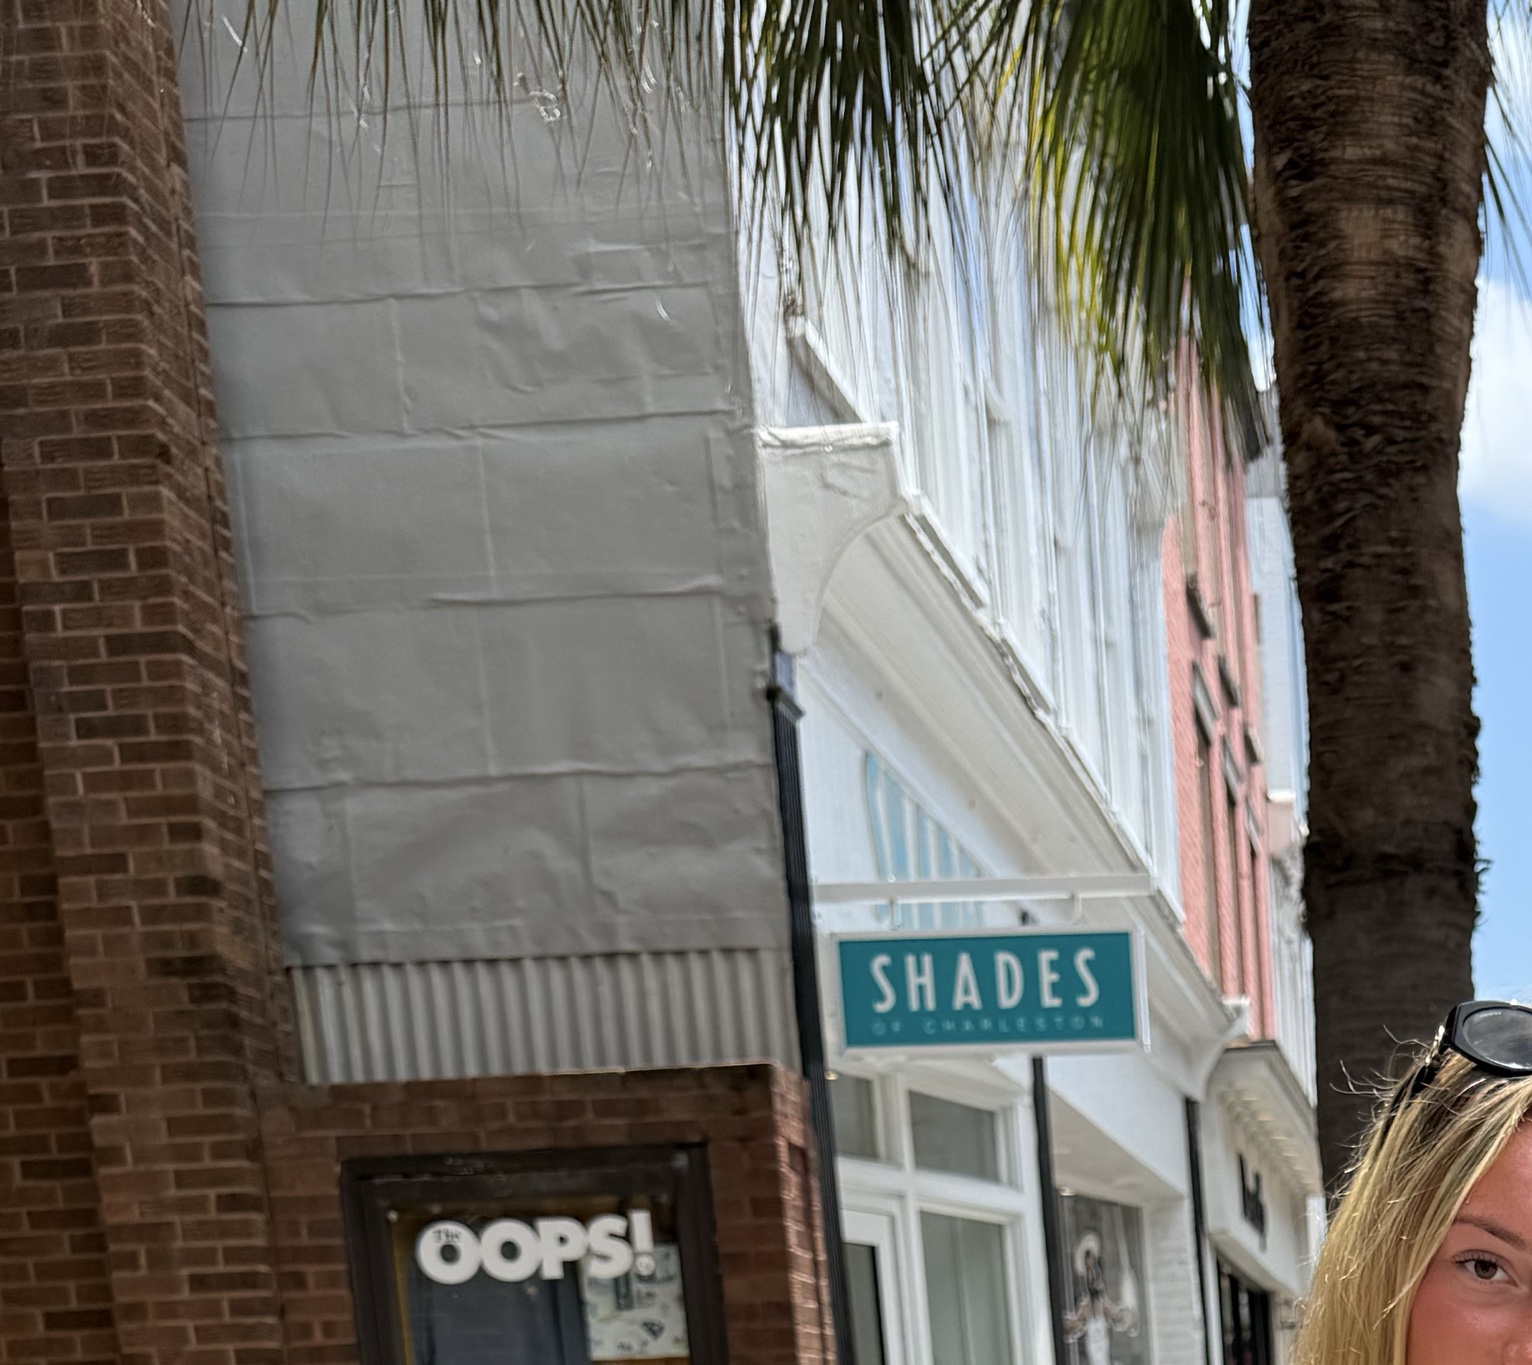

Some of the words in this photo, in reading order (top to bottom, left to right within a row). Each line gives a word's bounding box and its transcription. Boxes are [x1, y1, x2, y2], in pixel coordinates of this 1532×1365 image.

[870, 947, 1100, 1013] SHADES
[922, 1015, 1105, 1035] CHARLESTON
[416, 1209, 656, 1285] OOPS!
